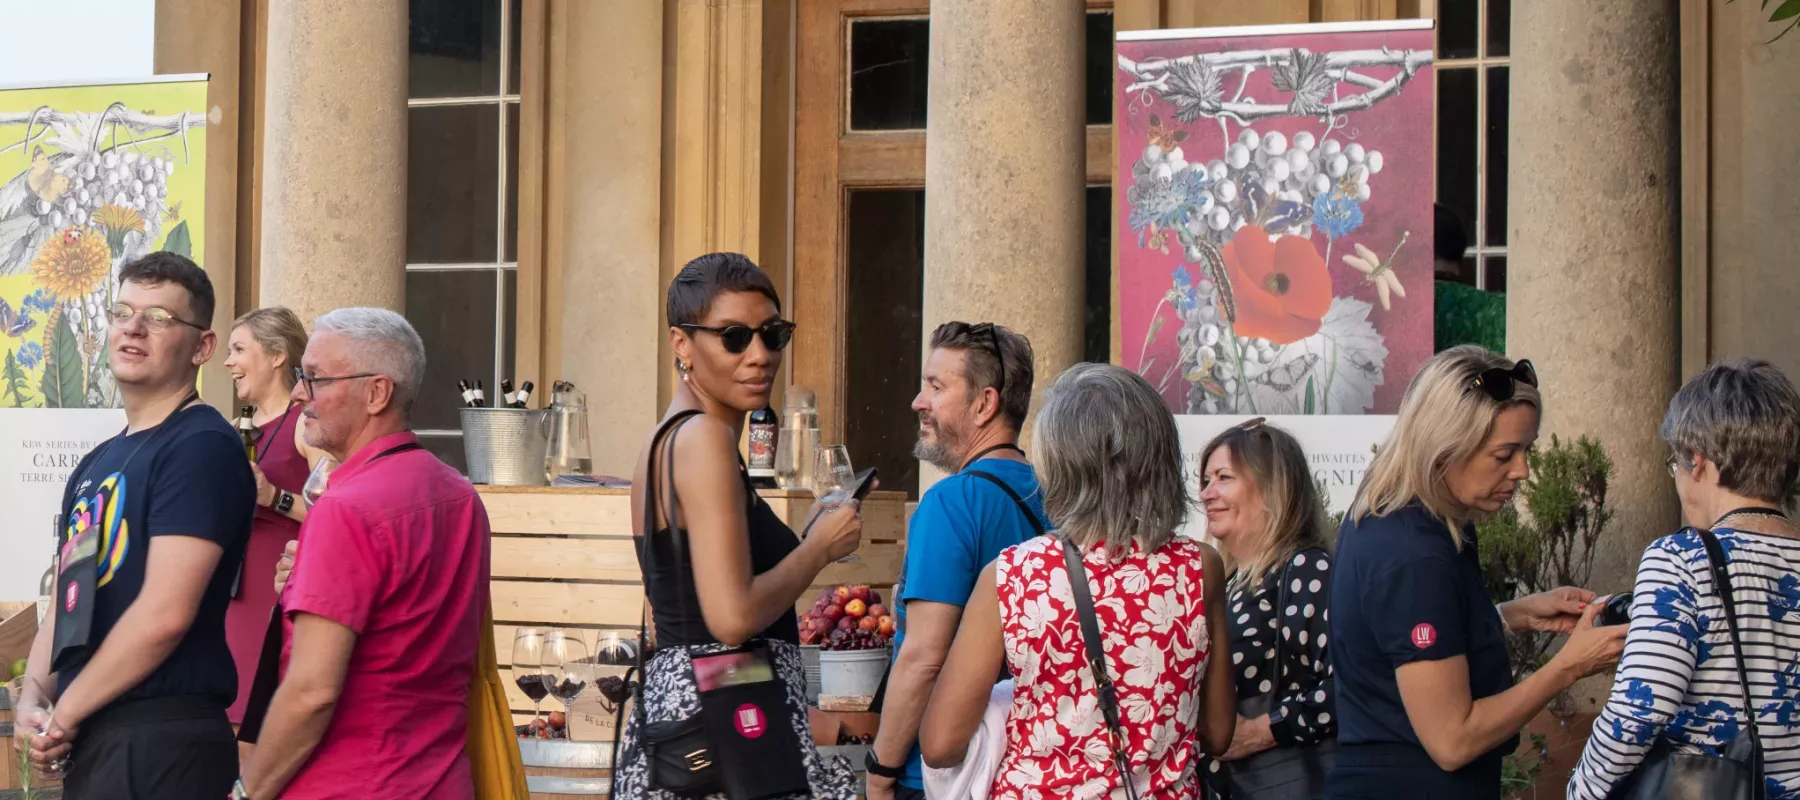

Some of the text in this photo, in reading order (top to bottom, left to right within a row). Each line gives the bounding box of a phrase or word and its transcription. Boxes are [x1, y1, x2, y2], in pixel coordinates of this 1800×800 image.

[21, 440, 42, 449] KEW
[45, 440, 78, 449] SERIES
[80, 440, 92, 449] BY
[32, 453, 80, 468] CARR
[19, 472, 55, 483] TERRE
[1416, 626, 1431, 641] LW
[584, 714, 594, 724] DE
[595, 718, 605, 727] LA
